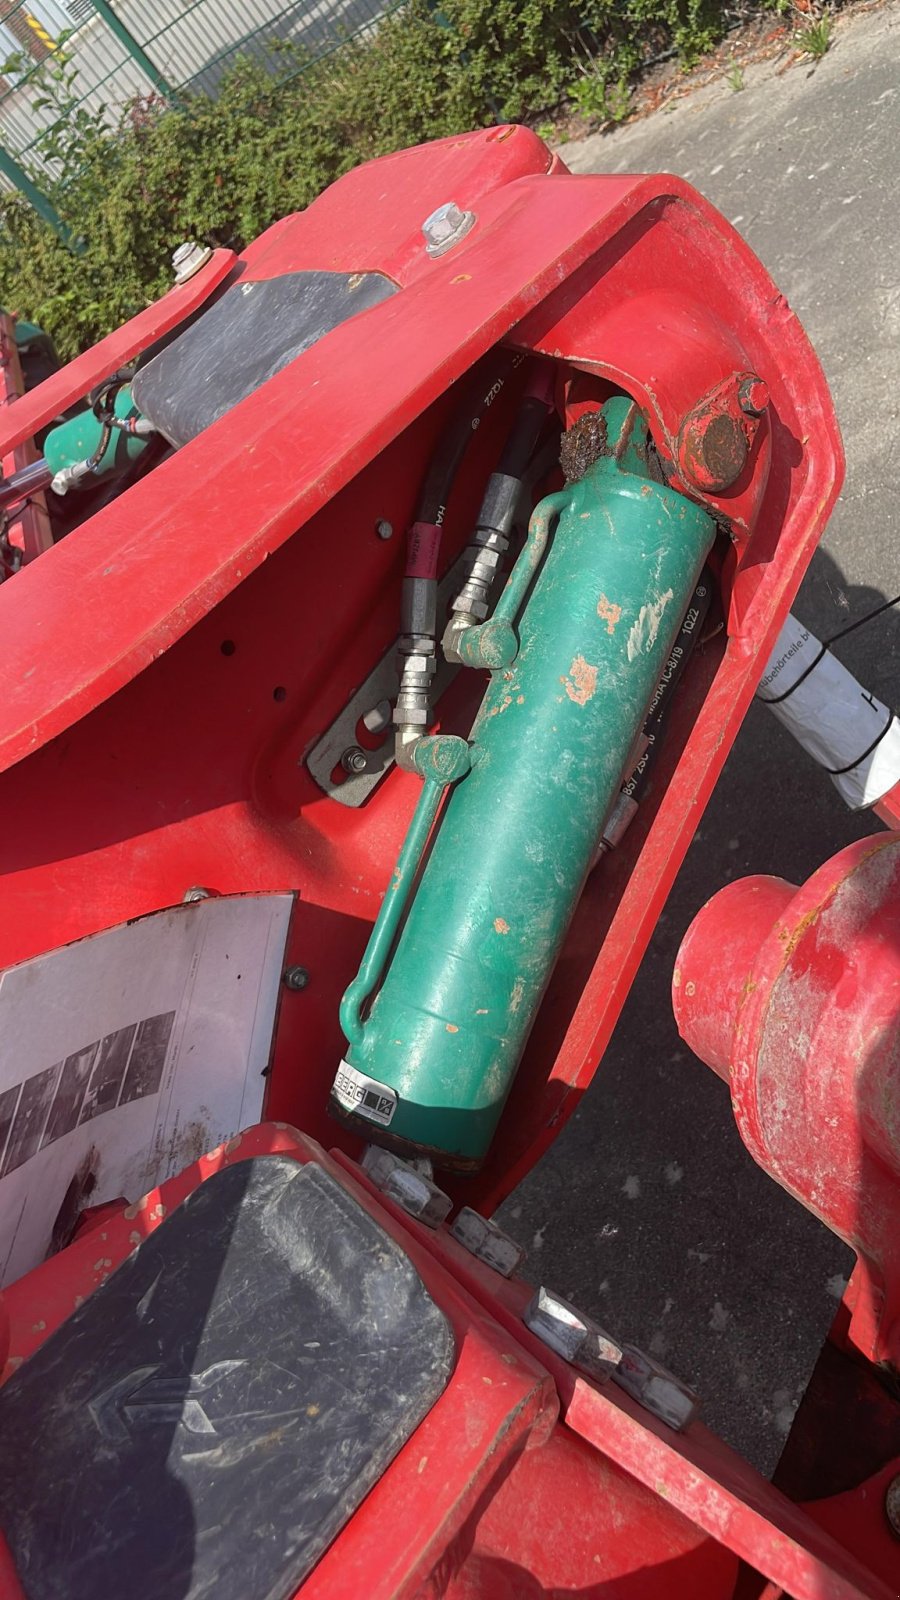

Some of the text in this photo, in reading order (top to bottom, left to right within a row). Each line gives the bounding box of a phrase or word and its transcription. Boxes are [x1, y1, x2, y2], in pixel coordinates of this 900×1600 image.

[484, 377, 505, 407] 1Q22
[661, 647, 683, 682] IC-8/19
[682, 608, 700, 634] 1Q22
[336, 1073, 365, 1102] BERG
